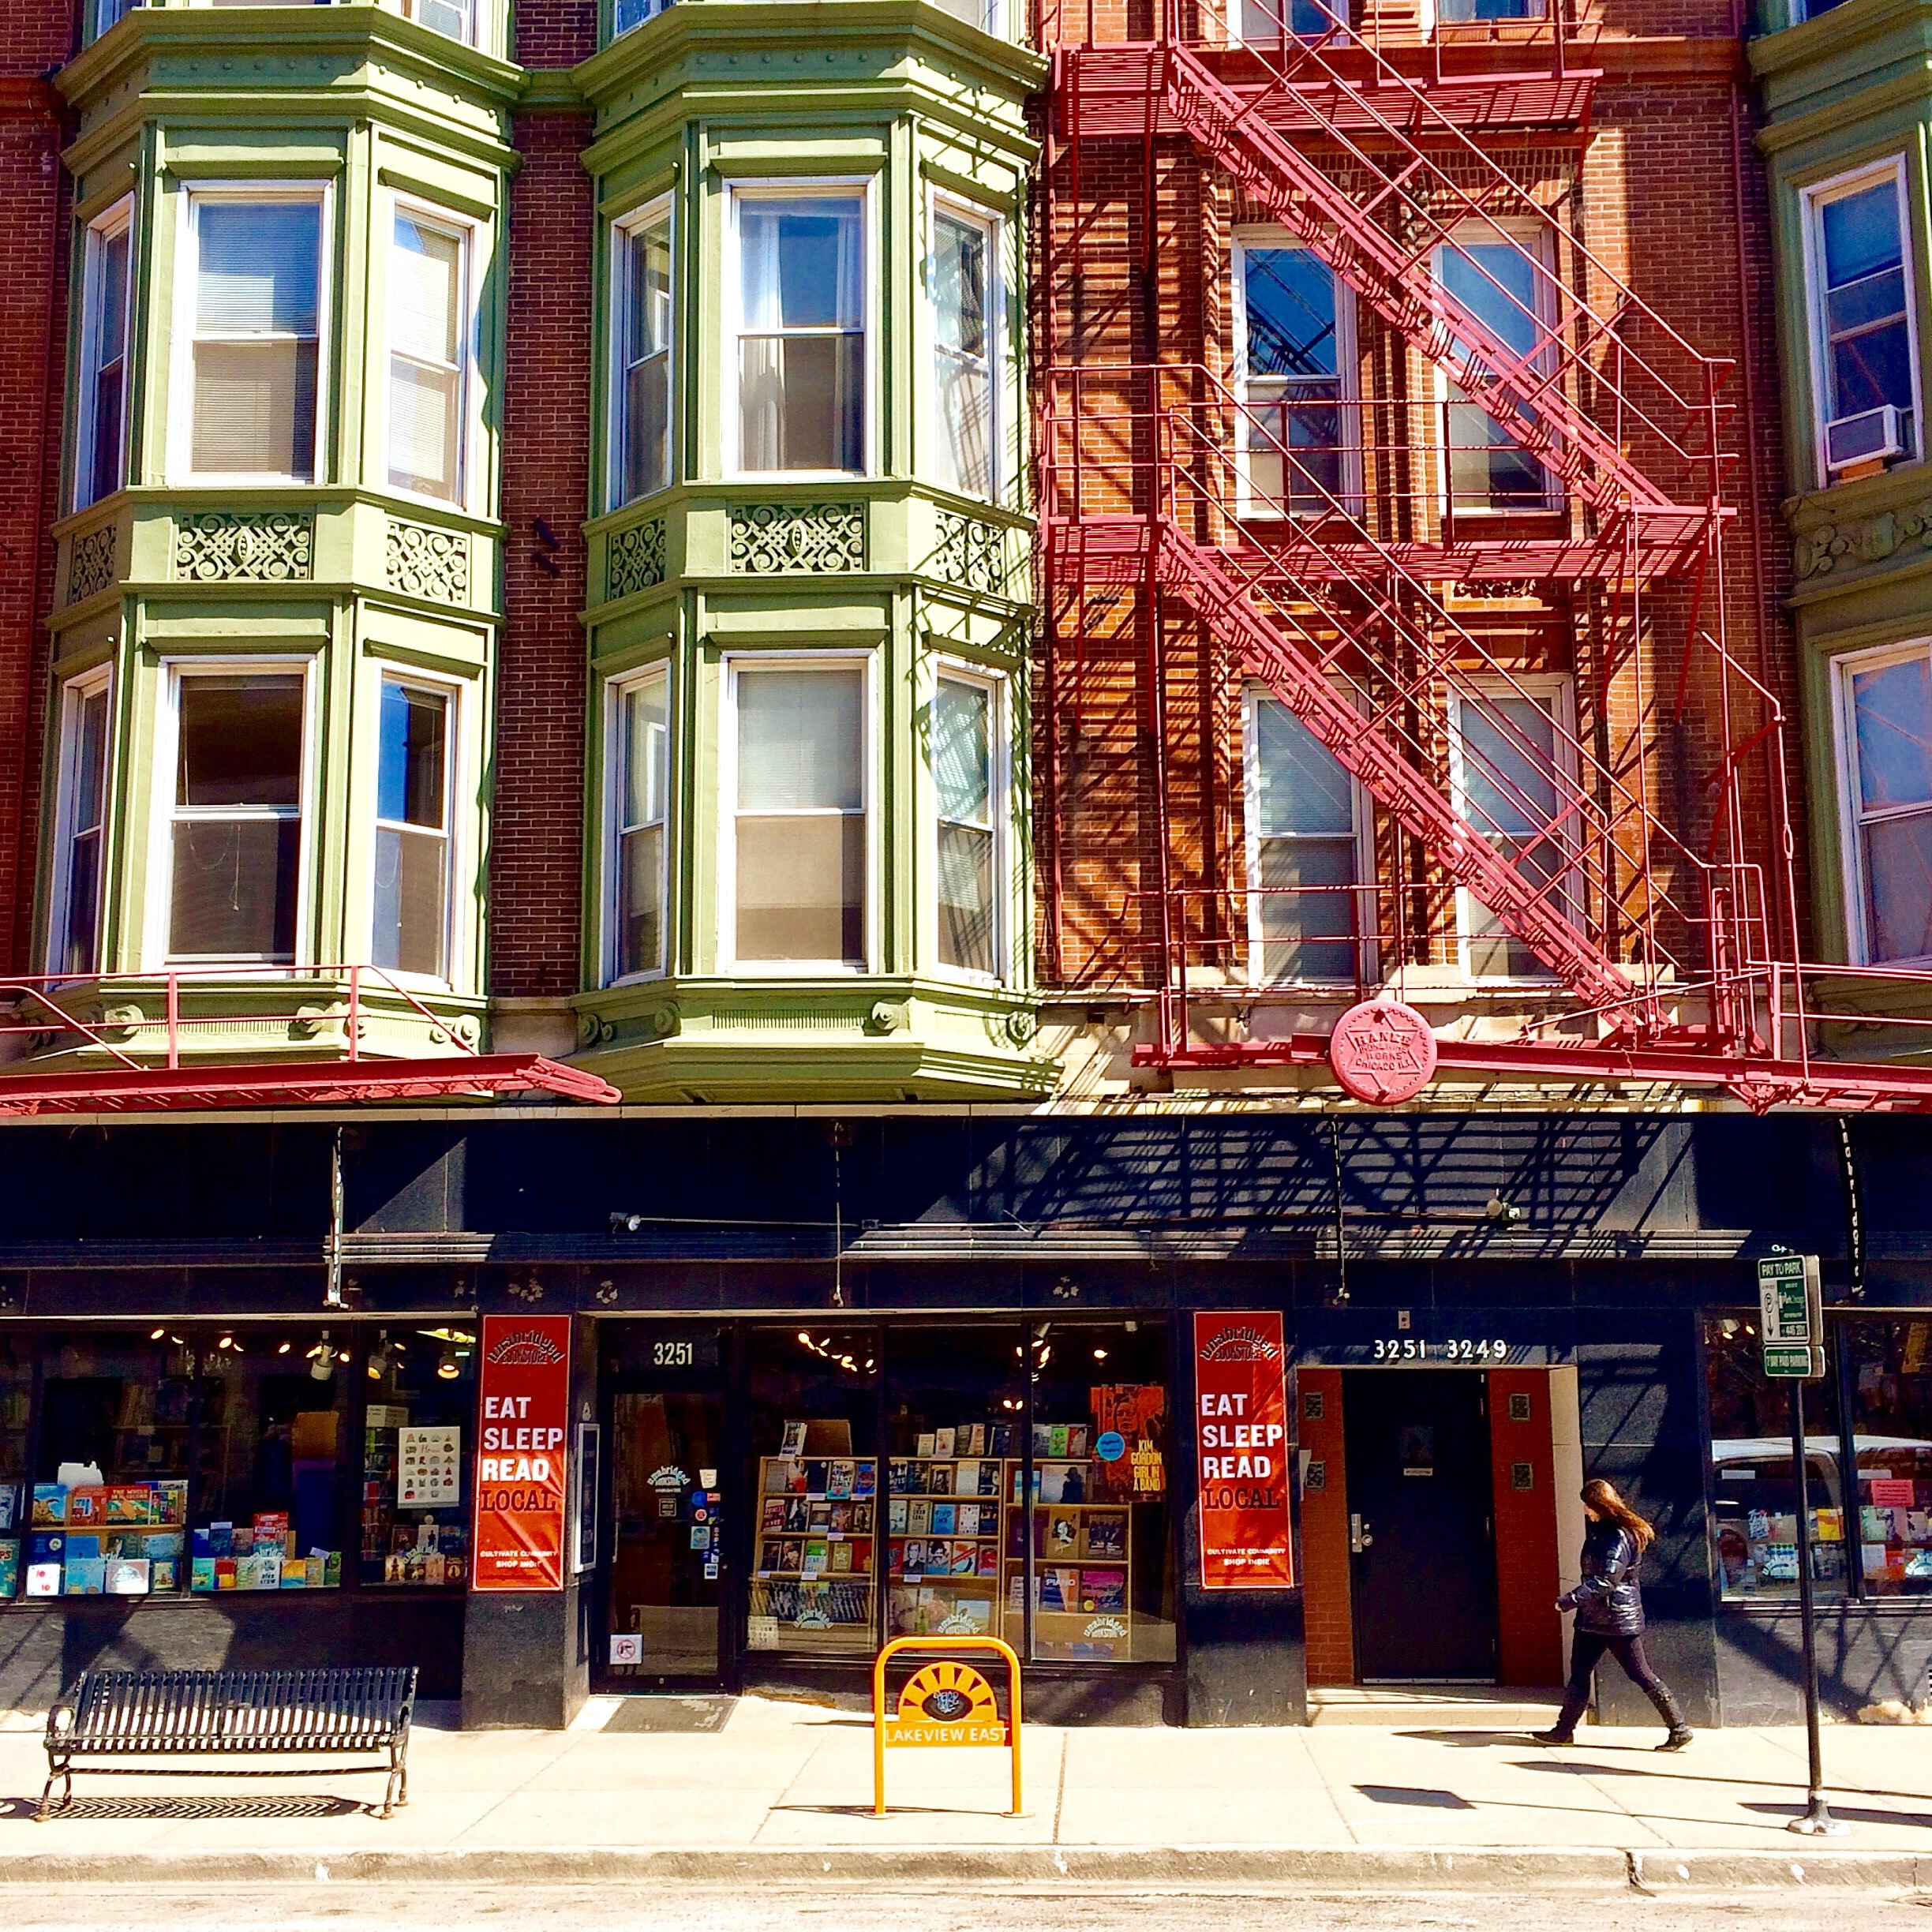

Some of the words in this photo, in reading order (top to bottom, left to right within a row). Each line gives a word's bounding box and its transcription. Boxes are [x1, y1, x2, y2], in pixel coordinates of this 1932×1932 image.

[1762, 1264, 1774, 1277] PAY
[1775, 1263, 1784, 1275] TO
[1784, 1261, 1803, 1275] PARK
[653, 1342, 693, 1365] 3251
[1374, 1339, 1426, 1359] 3251
[1447, 1339, 1507, 1359] 3249
[485, 1396, 532, 1419] EAT
[1201, 1393, 1248, 1416] EAT
[483, 1427, 564, 1451] SLEEP
[1139, 1440, 1154, 1453] KIM
[1202, 1424, 1282, 1447] SLEEP
[481, 1458, 550, 1482] READ
[1130, 1452, 1163, 1466] GORDON
[1203, 1455, 1271, 1479] READ
[1133, 1466, 1150, 1478] GIRL
[1150, 1466, 1160, 1478] IN
[1133, 1478, 1139, 1492] A
[1140, 1478, 1161, 1492] BAND
[481, 1489, 556, 1512] LOCAL
[1204, 1487, 1280, 1511] LOCAL
[886, 1728, 964, 1742] LAKEVIEW
[969, 1727, 1009, 1742] EAST
